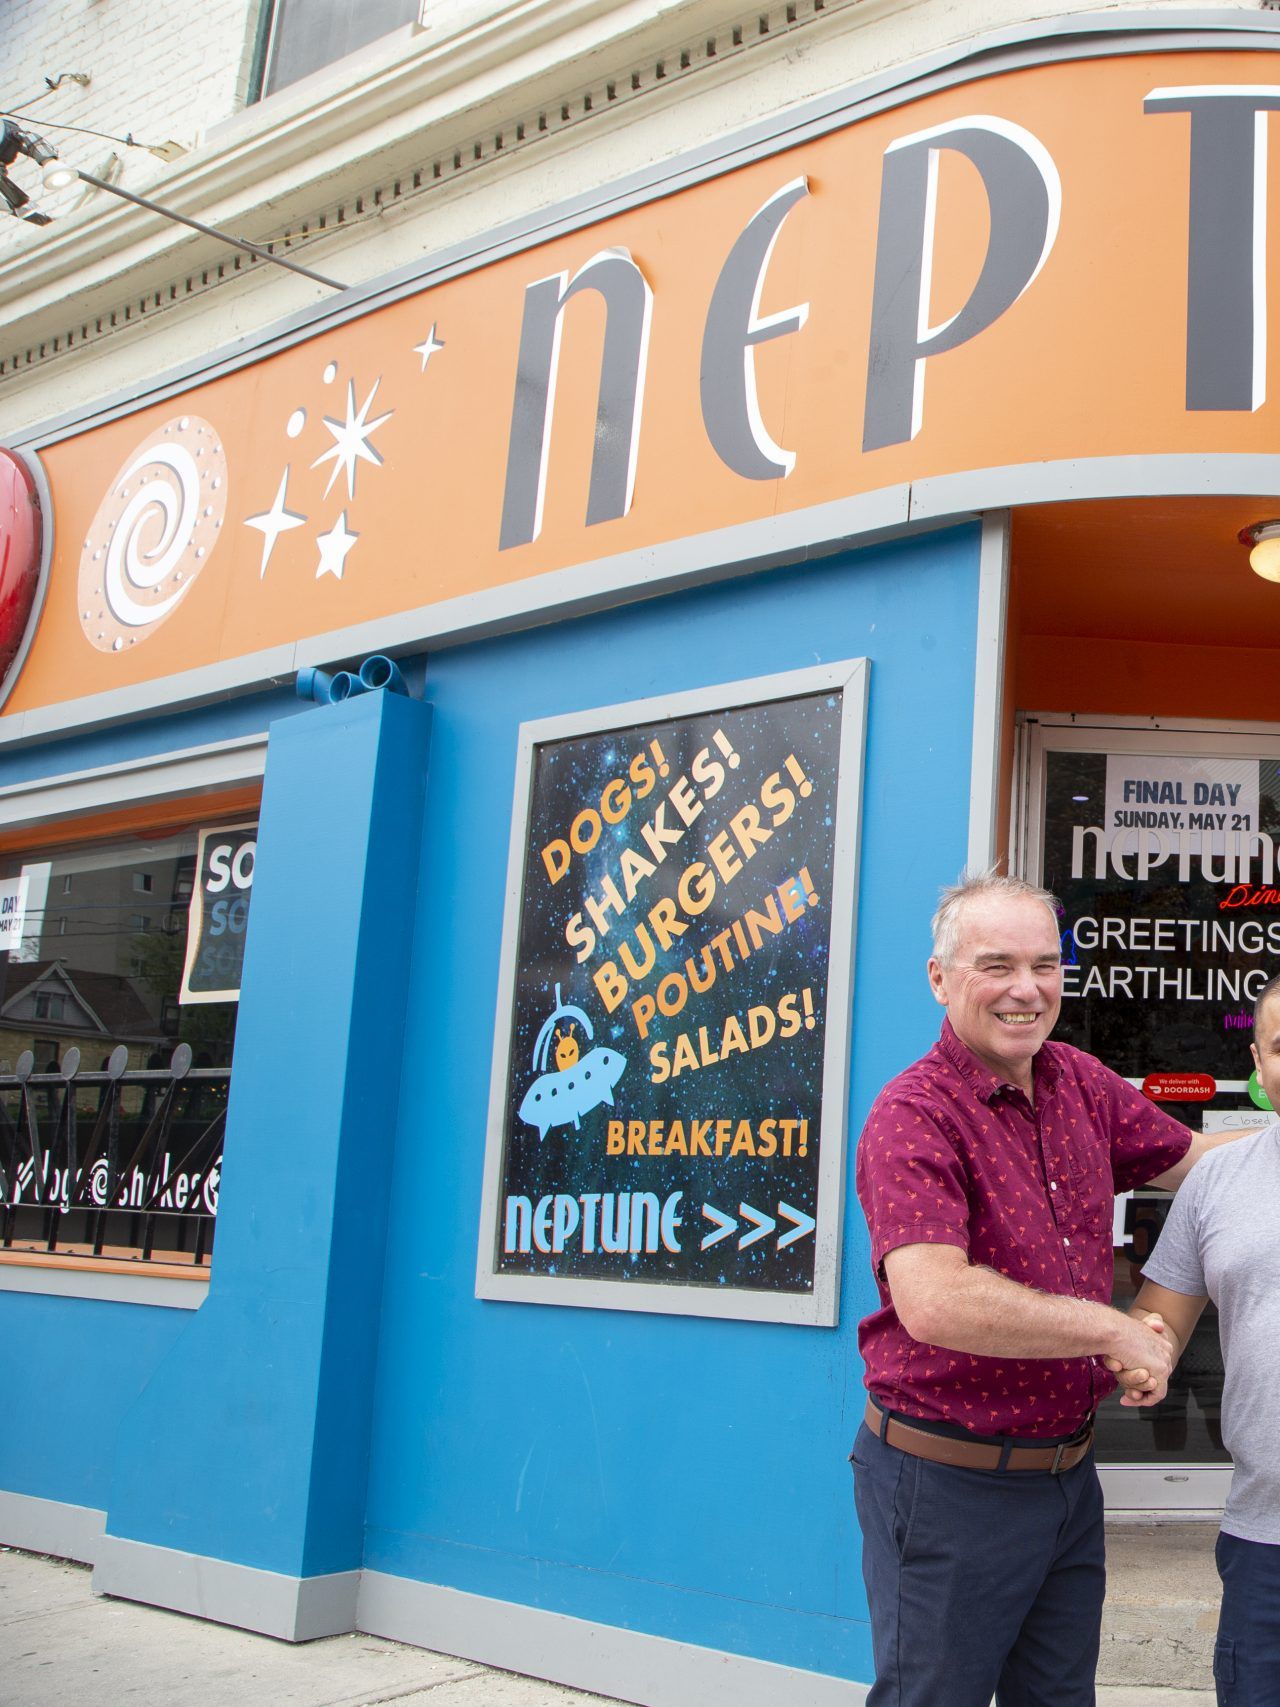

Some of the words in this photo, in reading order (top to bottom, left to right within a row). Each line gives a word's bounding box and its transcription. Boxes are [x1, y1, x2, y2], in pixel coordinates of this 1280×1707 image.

[542, 738, 670, 884] DOGS!
[1123, 780, 1188, 805] FINAL
[1193, 782, 1242, 806] DAY
[1113, 810, 1184, 830] SUNDAY,
[1189, 813, 1227, 831] MAY
[1231, 814, 1250, 831] 21
[565, 729, 742, 964] SHAKES!
[592, 753, 813, 1014] BURGERS!
[2, 895, 20, 914] DAY
[631, 867, 819, 1040] POUTINE!
[1061, 965, 1270, 1001] EARTHLING
[649, 988, 817, 1084] SALADS!
[1164, 1086, 1211, 1094] DOORDASH
[607, 1119, 809, 1157] BREAKFAST!
[1222, 1115, 1271, 1126] Closed
